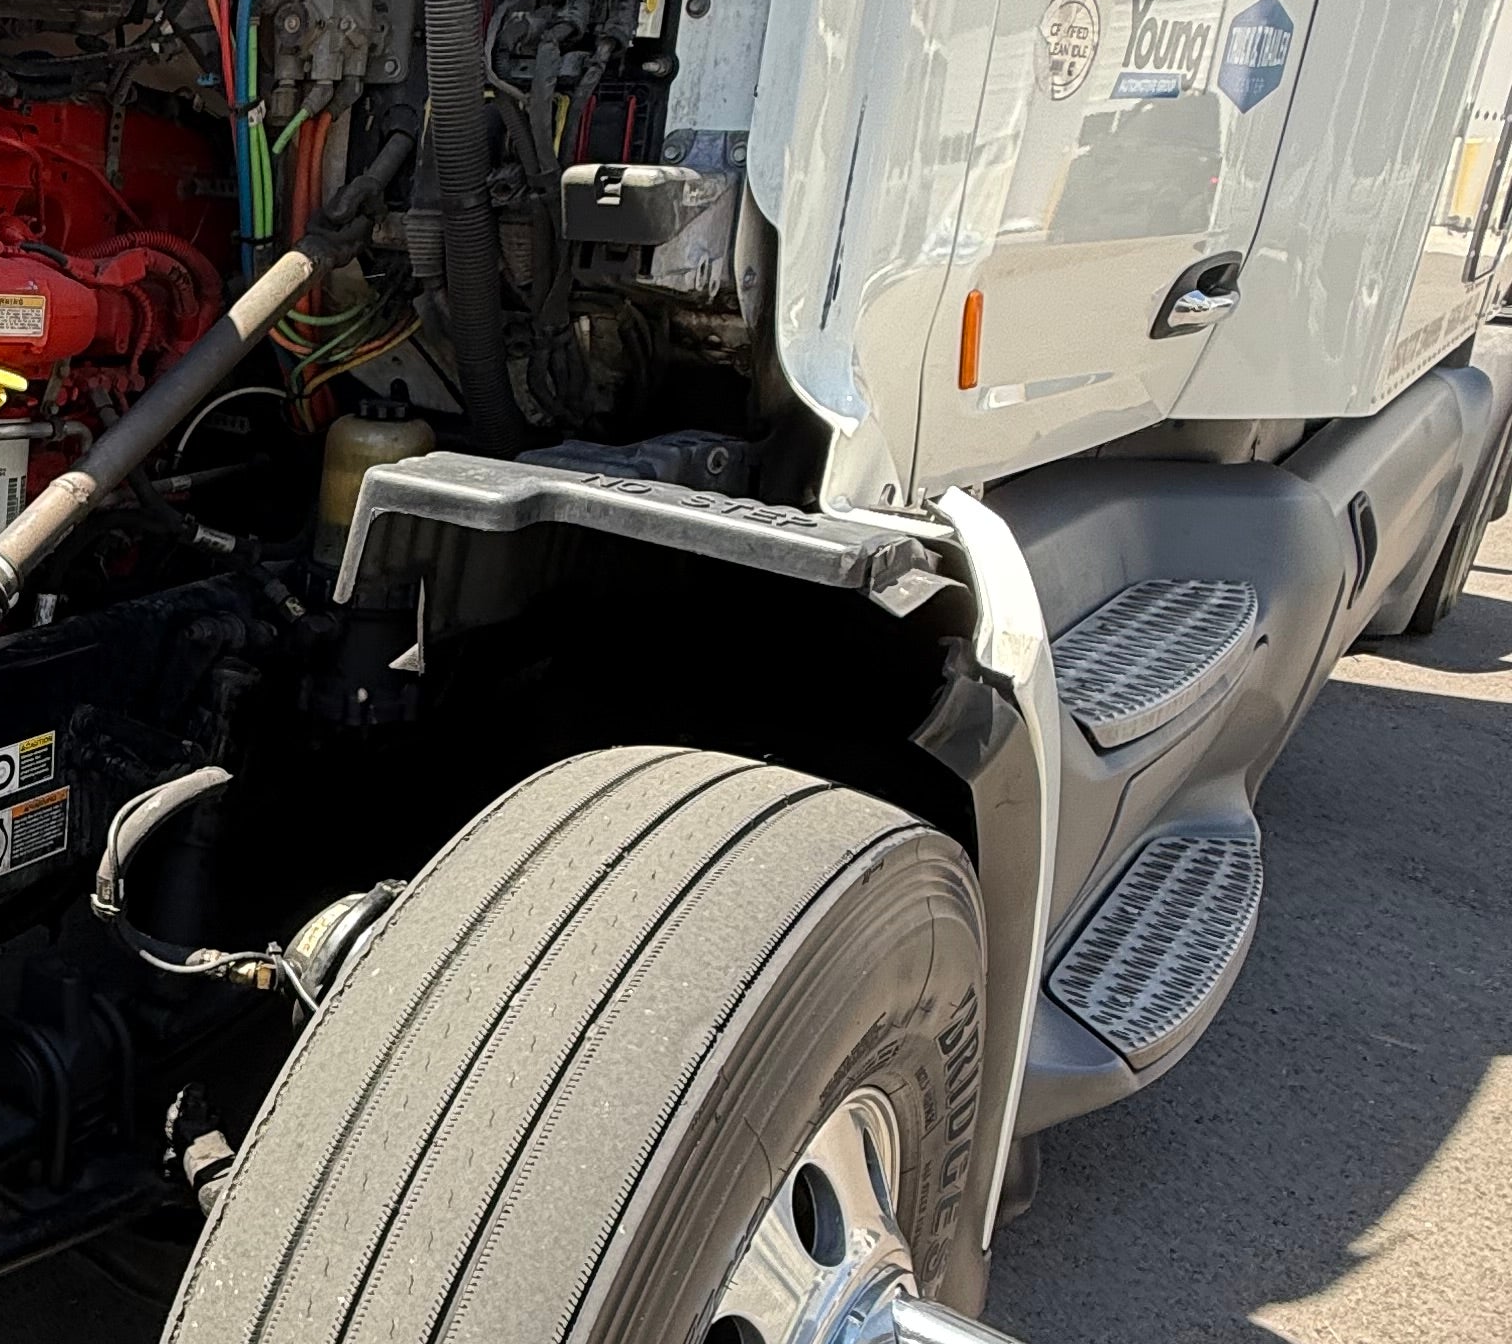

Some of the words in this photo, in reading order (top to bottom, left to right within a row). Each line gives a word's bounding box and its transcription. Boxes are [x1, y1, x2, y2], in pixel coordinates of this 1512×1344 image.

[1048, 42, 1069, 56] LEAN
[581, 472, 652, 494] NO
[681, 495, 818, 527] STEP
